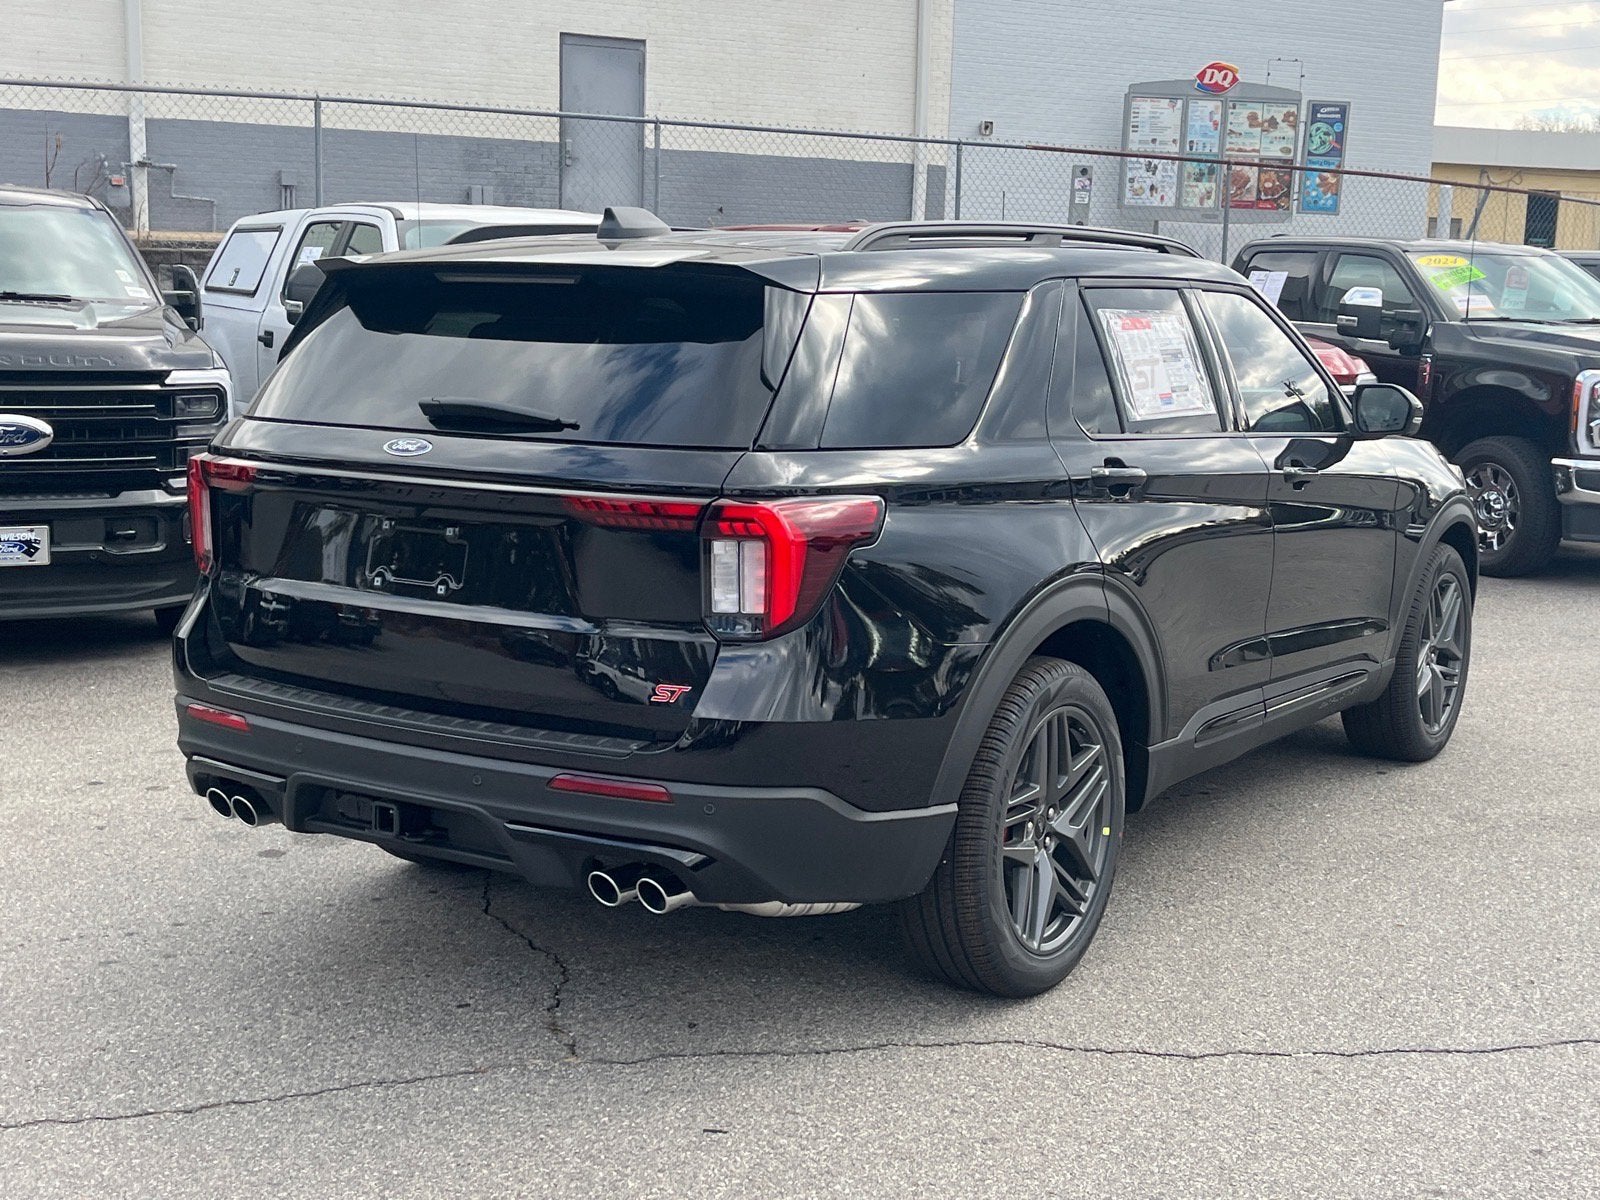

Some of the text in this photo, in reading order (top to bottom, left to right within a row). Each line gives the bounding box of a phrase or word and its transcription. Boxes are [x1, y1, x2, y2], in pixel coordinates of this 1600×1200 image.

[1203, 68, 1234, 88] DQ
[1426, 257, 1459, 266] 2024
[650, 684, 693, 703] ST
